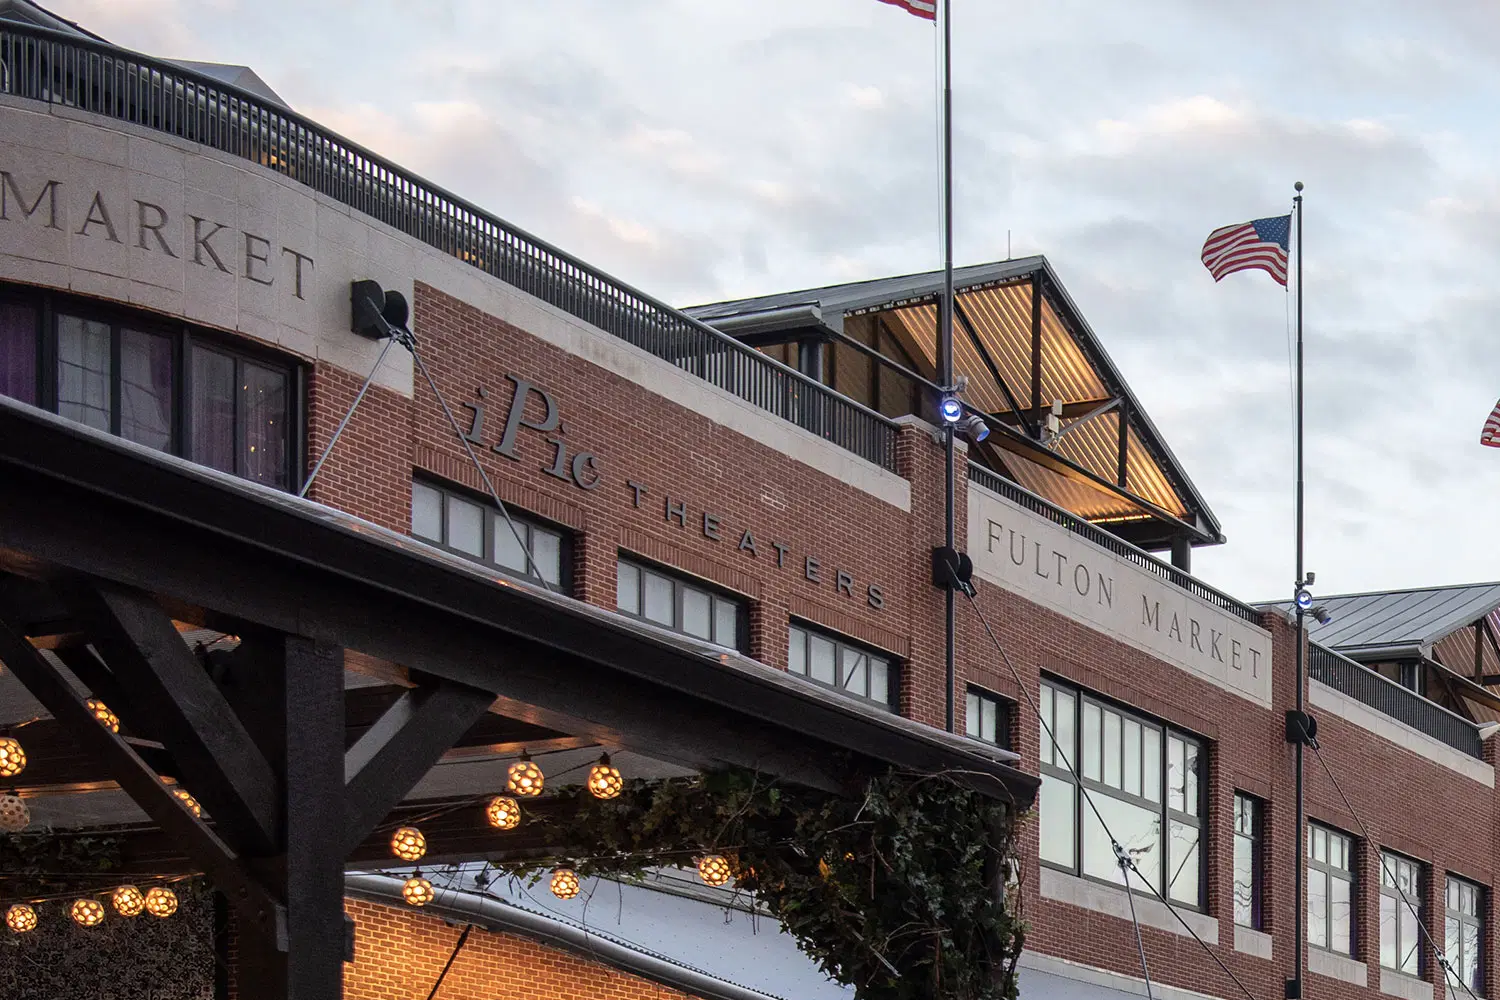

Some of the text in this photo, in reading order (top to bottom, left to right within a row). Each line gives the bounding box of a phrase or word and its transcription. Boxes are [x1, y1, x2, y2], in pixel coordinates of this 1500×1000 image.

[0, 170, 315, 301] MARKET
[463, 372, 886, 610] iPic THEATERS
[986, 518, 1261, 680] FULTON MARKET
